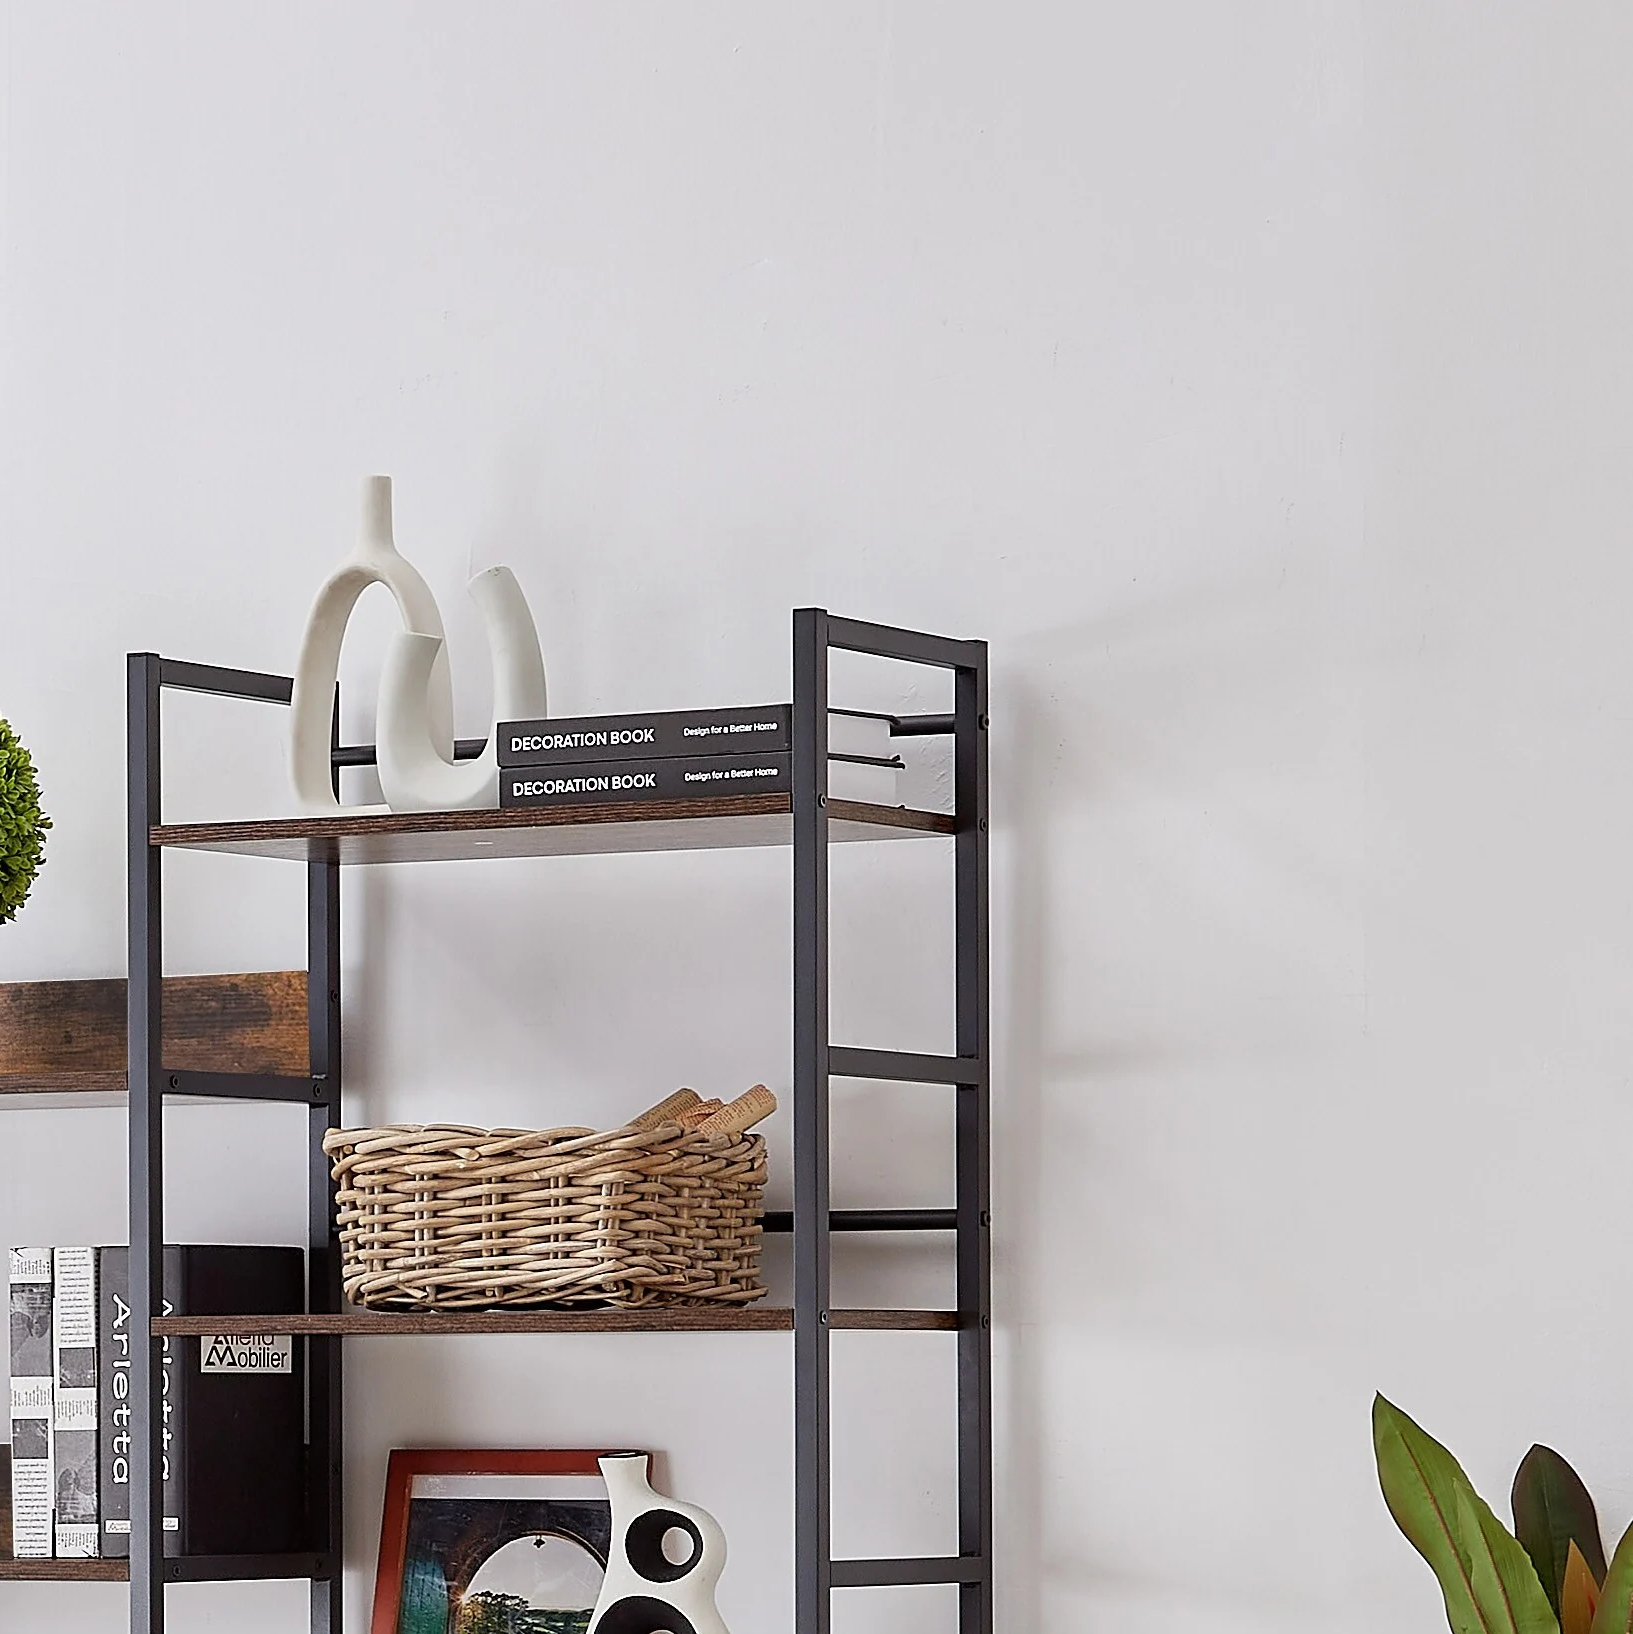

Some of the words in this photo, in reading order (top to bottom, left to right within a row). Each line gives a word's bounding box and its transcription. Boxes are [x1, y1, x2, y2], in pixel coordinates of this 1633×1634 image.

[511, 731, 607, 752] DECORATION
[610, 728, 655, 745] BOOK
[683, 727, 710, 737] Design
[711, 725, 722, 734] for
[729, 724, 753, 733] Better
[754, 722, 777, 731] Home
[512, 776, 608, 796] DECORATION
[611, 774, 656, 790] BOOK
[684, 772, 711, 782] Design
[712, 770, 723, 779] for
[730, 769, 754, 778] Better
[755, 768, 778, 776] Home
[204, 1345, 288, 1368] Mobilier
[112, 1293, 131, 1484] Arletta
